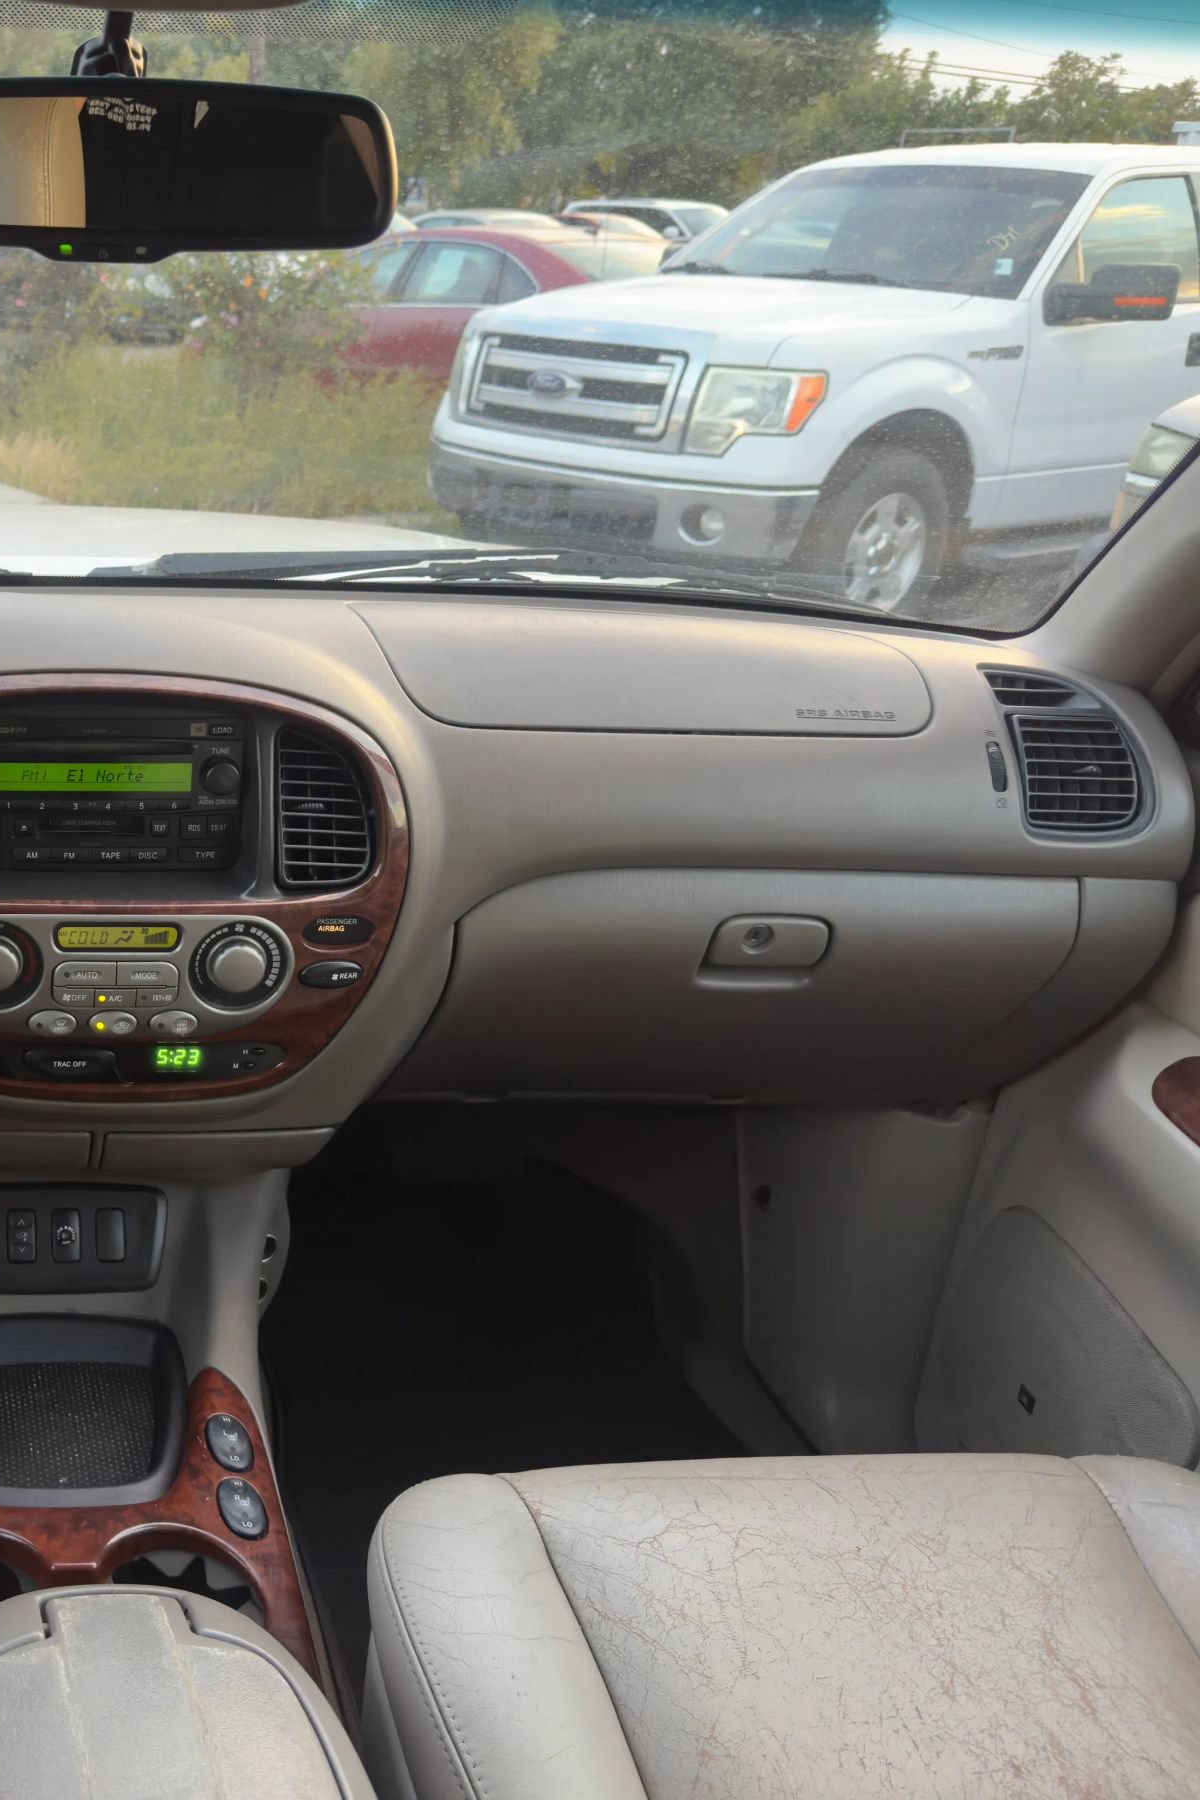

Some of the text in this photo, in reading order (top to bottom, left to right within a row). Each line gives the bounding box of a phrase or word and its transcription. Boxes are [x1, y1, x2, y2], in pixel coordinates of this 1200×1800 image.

[832, 708, 897, 720] AIRBAG
[212, 726, 233, 734] LOAD
[211, 747, 231, 755] TUNE
[67, 769, 85, 782] El
[96, 769, 144, 782] Norte
[39, 802, 45, 810] 2
[105, 802, 111, 810] 4
[138, 802, 145, 810] 5
[171, 802, 177, 810] 6
[153, 824, 166, 832] TEXT
[188, 824, 201, 832] RDS
[26, 851, 39, 859] AM
[63, 852, 76, 860] FM
[100, 852, 121, 860] TAPE
[138, 852, 158, 860] DISC
[68, 930, 109, 945] COLD
[75, 971, 98, 979] AUTO
[135, 972, 158, 980] MODE
[339, 972, 358, 980] REAR
[71, 994, 88, 1002] OFF
[156, 1048, 200, 1065] 5:23
